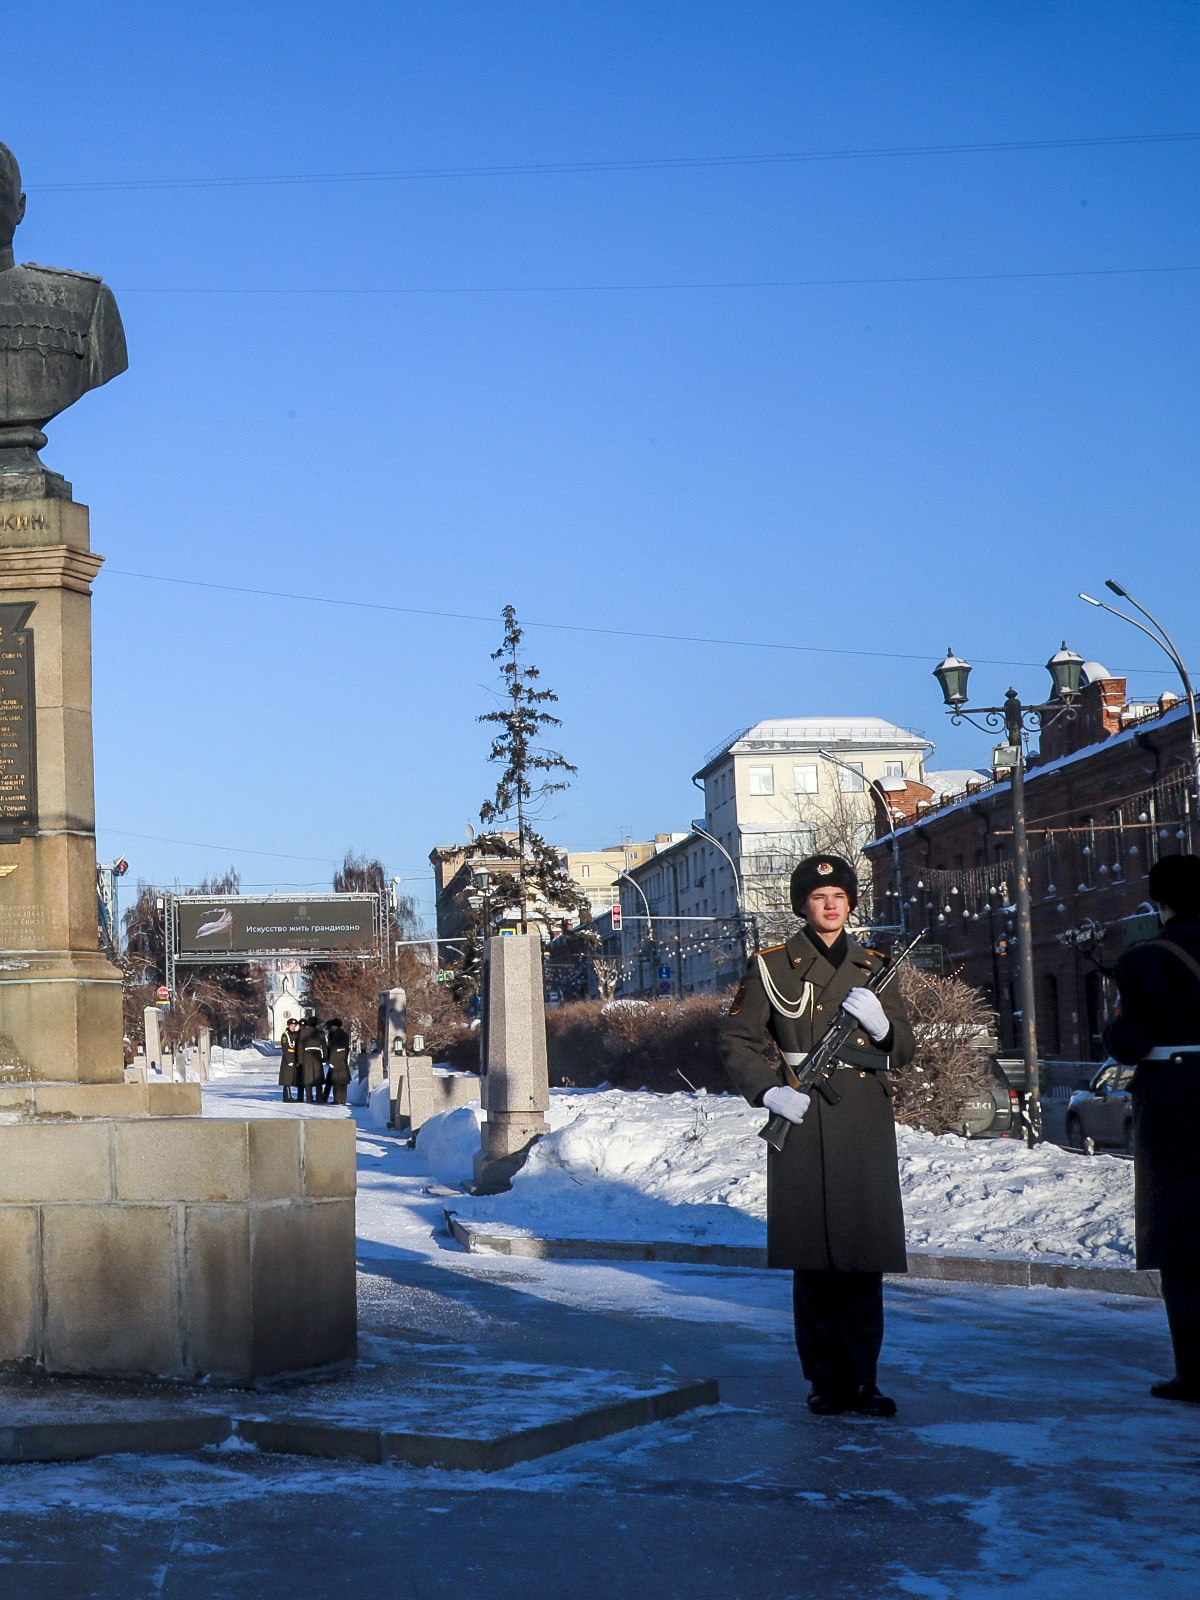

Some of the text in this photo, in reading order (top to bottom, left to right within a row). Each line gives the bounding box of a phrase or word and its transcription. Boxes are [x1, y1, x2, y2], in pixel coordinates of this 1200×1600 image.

[246, 924, 360, 934] Искусство жить грандиозно
